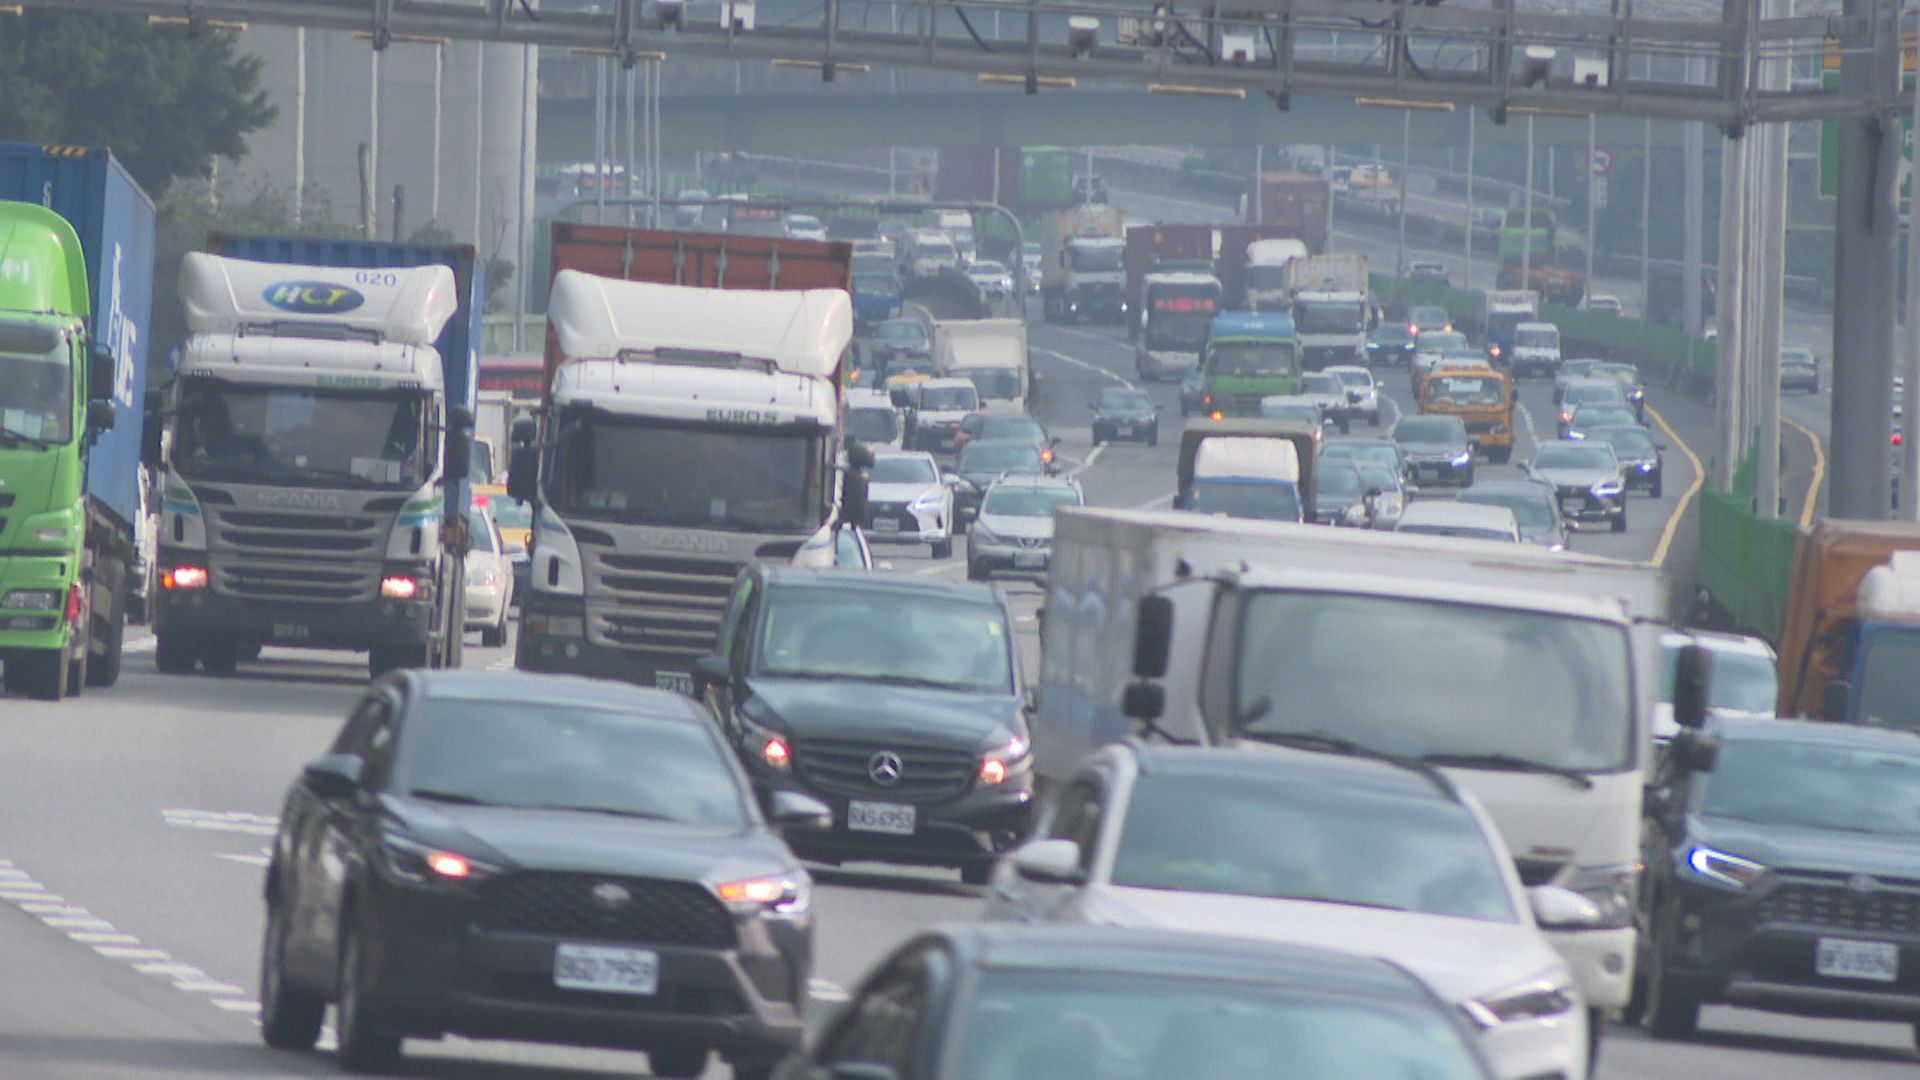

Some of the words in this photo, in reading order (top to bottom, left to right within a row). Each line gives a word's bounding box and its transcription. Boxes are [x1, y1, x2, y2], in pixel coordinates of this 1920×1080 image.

[355, 270, 398, 288] 020
[256, 491, 341, 508] SCANIA
[639, 530, 729, 552] SCANIA
